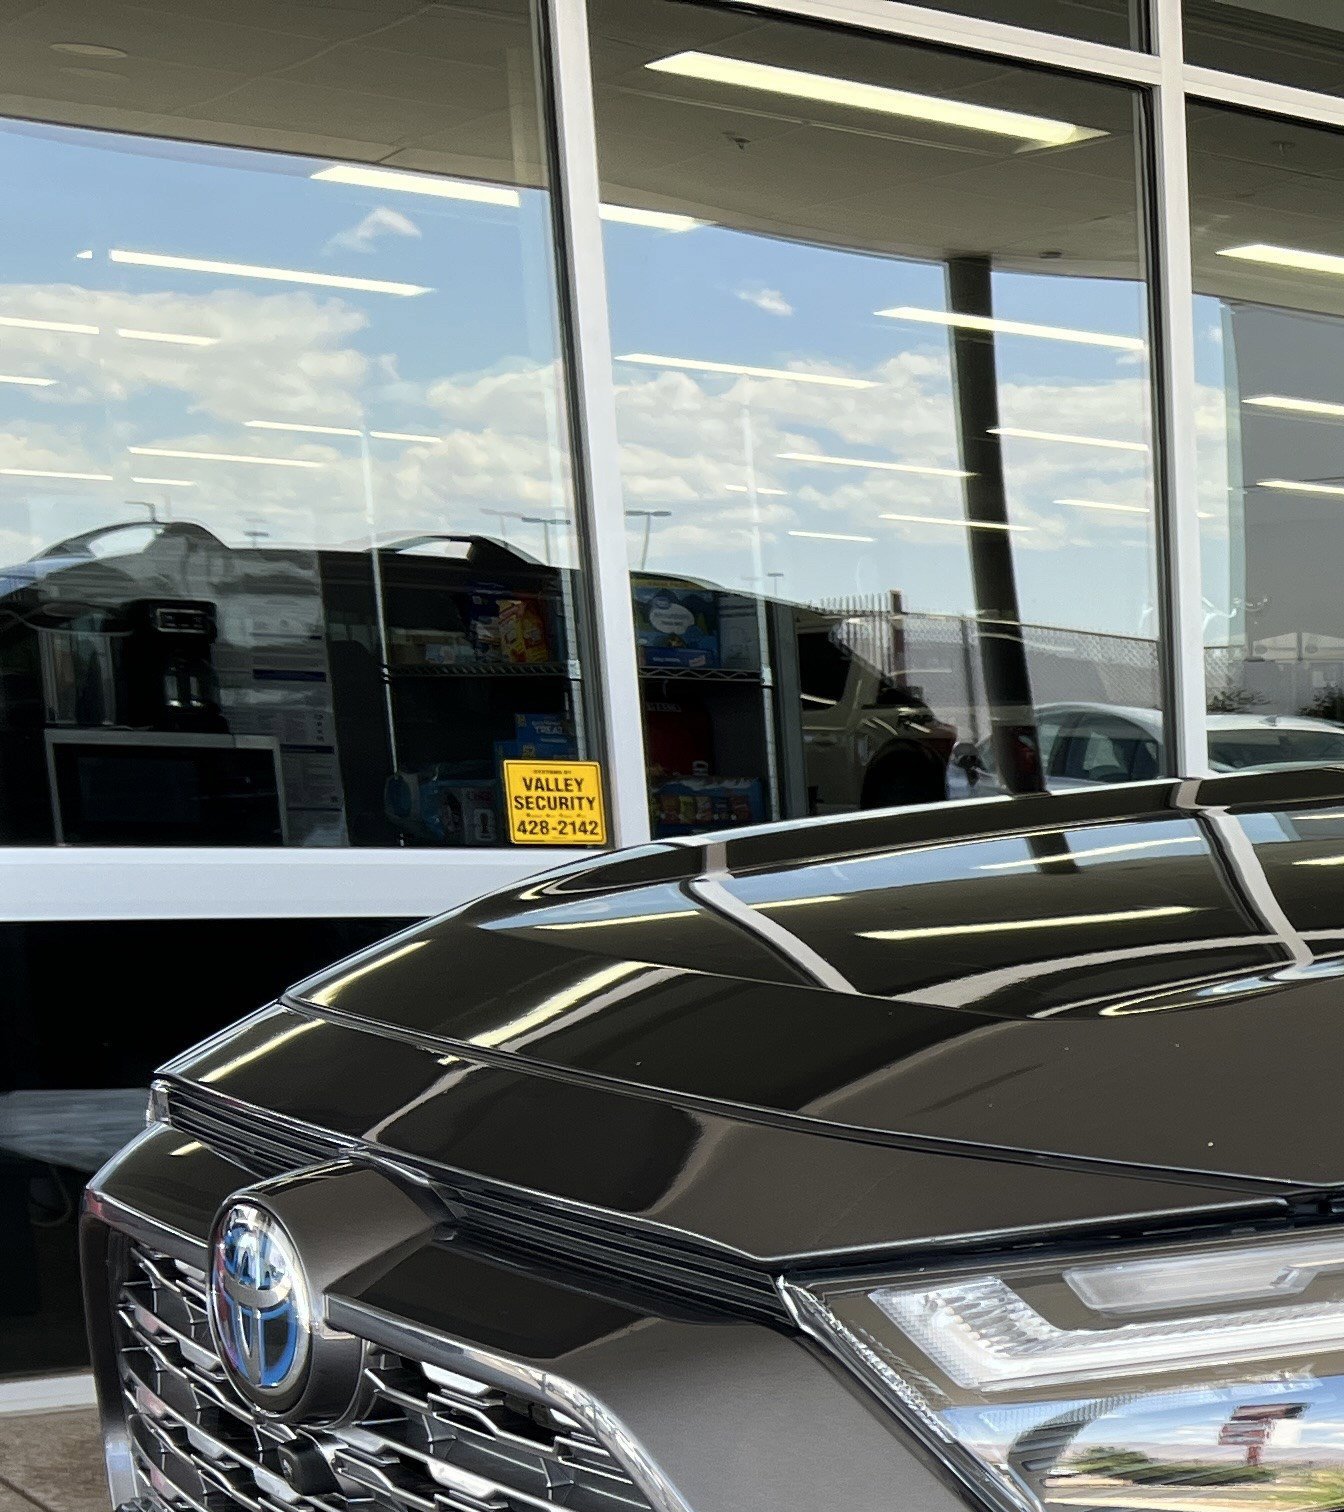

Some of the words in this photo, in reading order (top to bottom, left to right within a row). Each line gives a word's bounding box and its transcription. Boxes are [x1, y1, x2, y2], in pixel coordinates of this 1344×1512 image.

[522, 777, 584, 792] VALLEY
[514, 796, 596, 810] SECURITY
[517, 820, 599, 835] 428-2142
